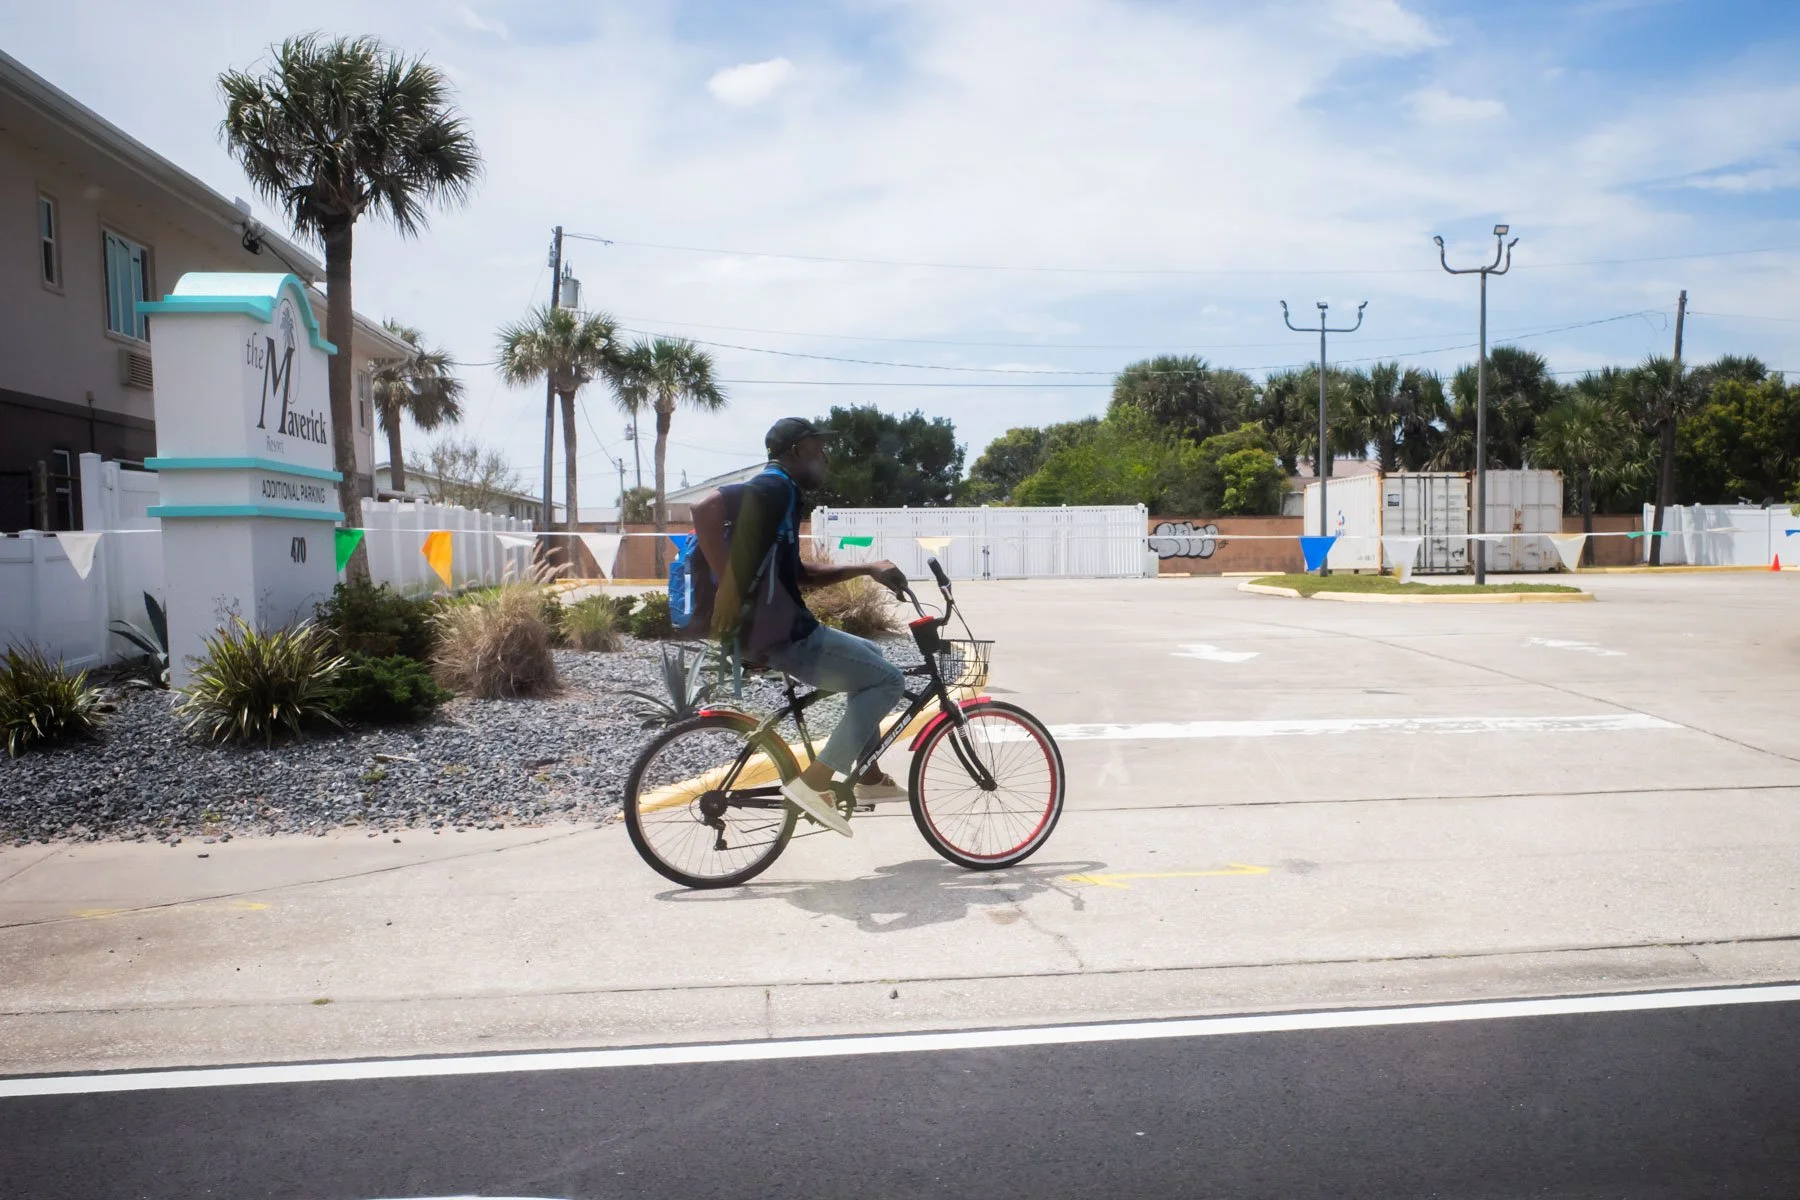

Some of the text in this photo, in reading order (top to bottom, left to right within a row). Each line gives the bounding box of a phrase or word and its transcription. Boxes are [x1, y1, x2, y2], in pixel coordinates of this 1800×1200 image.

[246, 333, 327, 445] the Maverick
[266, 435, 285, 455] Resort
[262, 480, 326, 504] ADDITIONAL PARKING
[290, 537, 307, 564] 470
